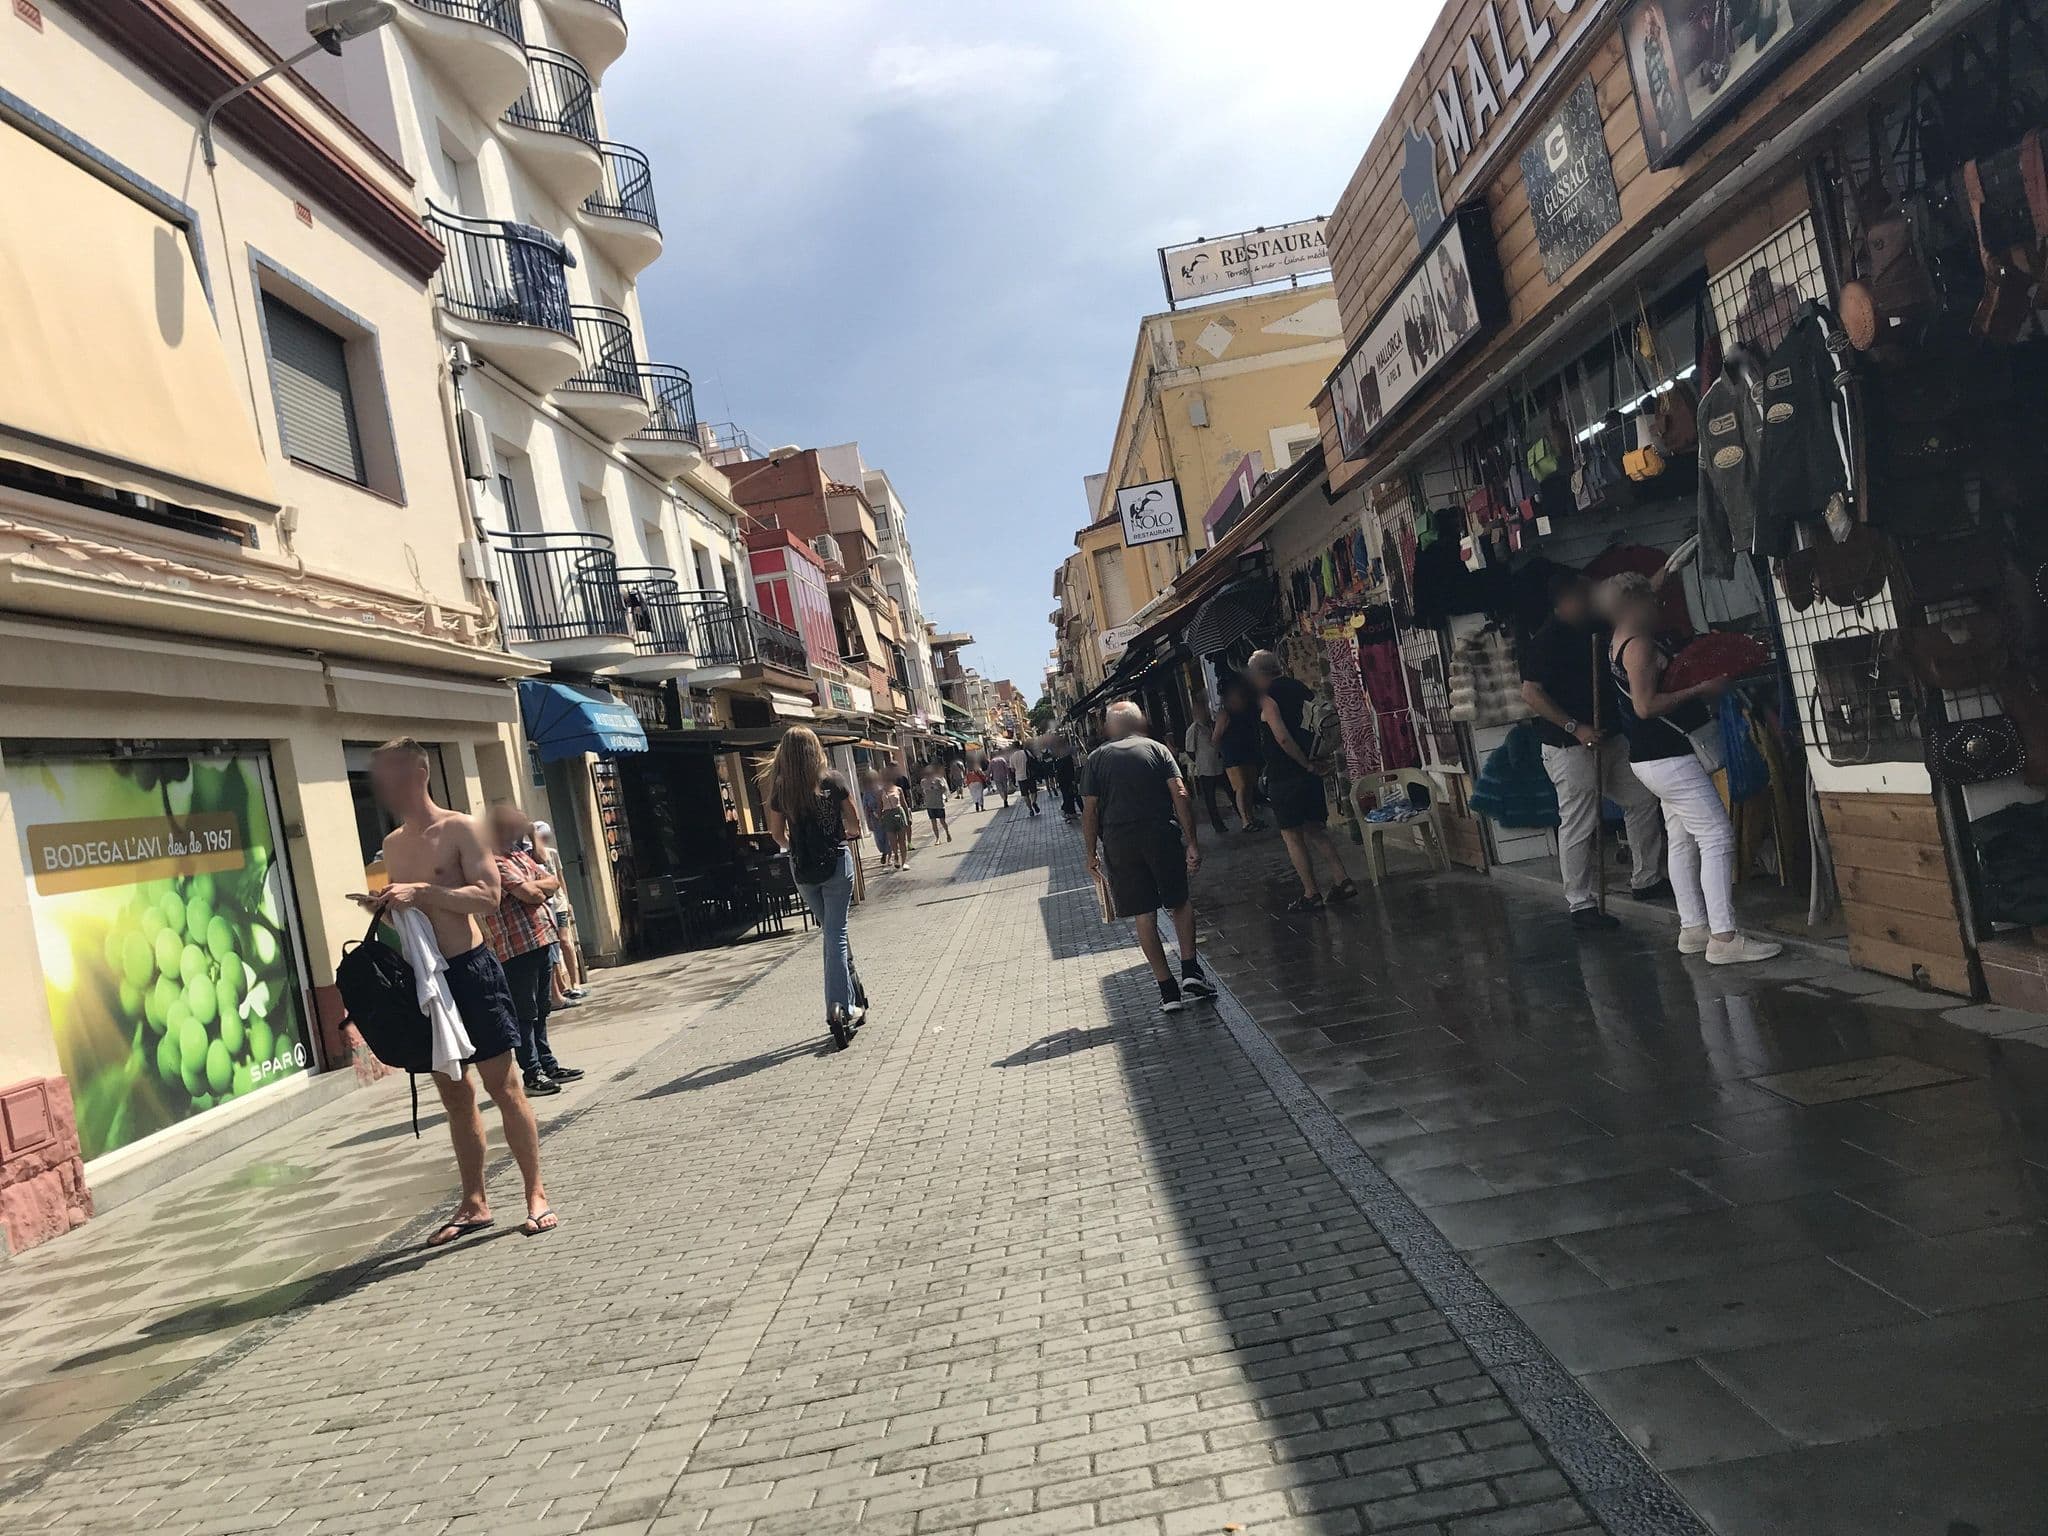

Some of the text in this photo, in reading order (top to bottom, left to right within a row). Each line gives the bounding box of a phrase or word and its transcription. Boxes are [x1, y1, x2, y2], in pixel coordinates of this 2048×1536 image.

[1434, 0, 1577, 176] MALL
[1543, 155, 1589, 217] GUSSACI
[1413, 190, 1437, 231] PIEL
[1561, 199, 1580, 226] ITALY
[1375, 329, 1403, 373] MALLORCA
[1133, 527, 1176, 540] RESTAURANT
[43, 840, 124, 870] BODEGA
[124, 836, 162, 861] L'AVI
[204, 829, 233, 851] 1967
[250, 1051, 293, 1083] SPAR
